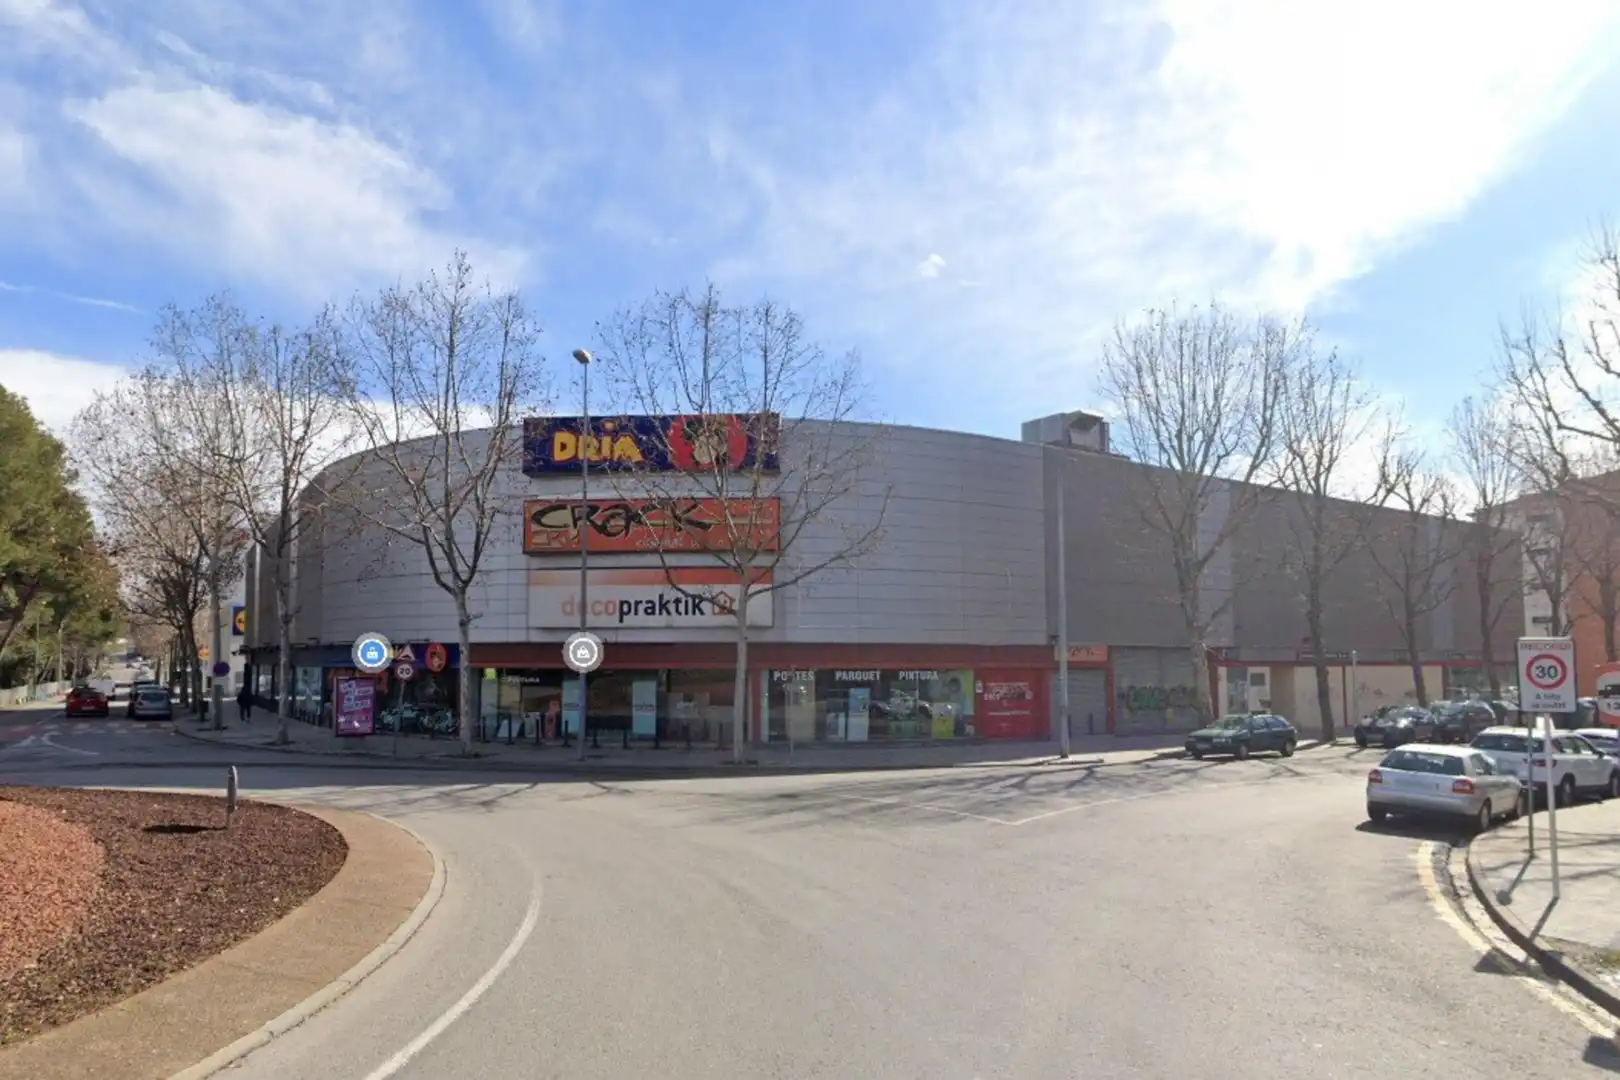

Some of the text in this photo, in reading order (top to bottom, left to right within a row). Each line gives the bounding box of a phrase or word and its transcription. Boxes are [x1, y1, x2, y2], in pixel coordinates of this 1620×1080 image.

[773, 670, 815, 681] POTES
[835, 670, 881, 681] PARQUET
[898, 670, 940, 681] PINTURA
[1535, 664, 1558, 681] 30
